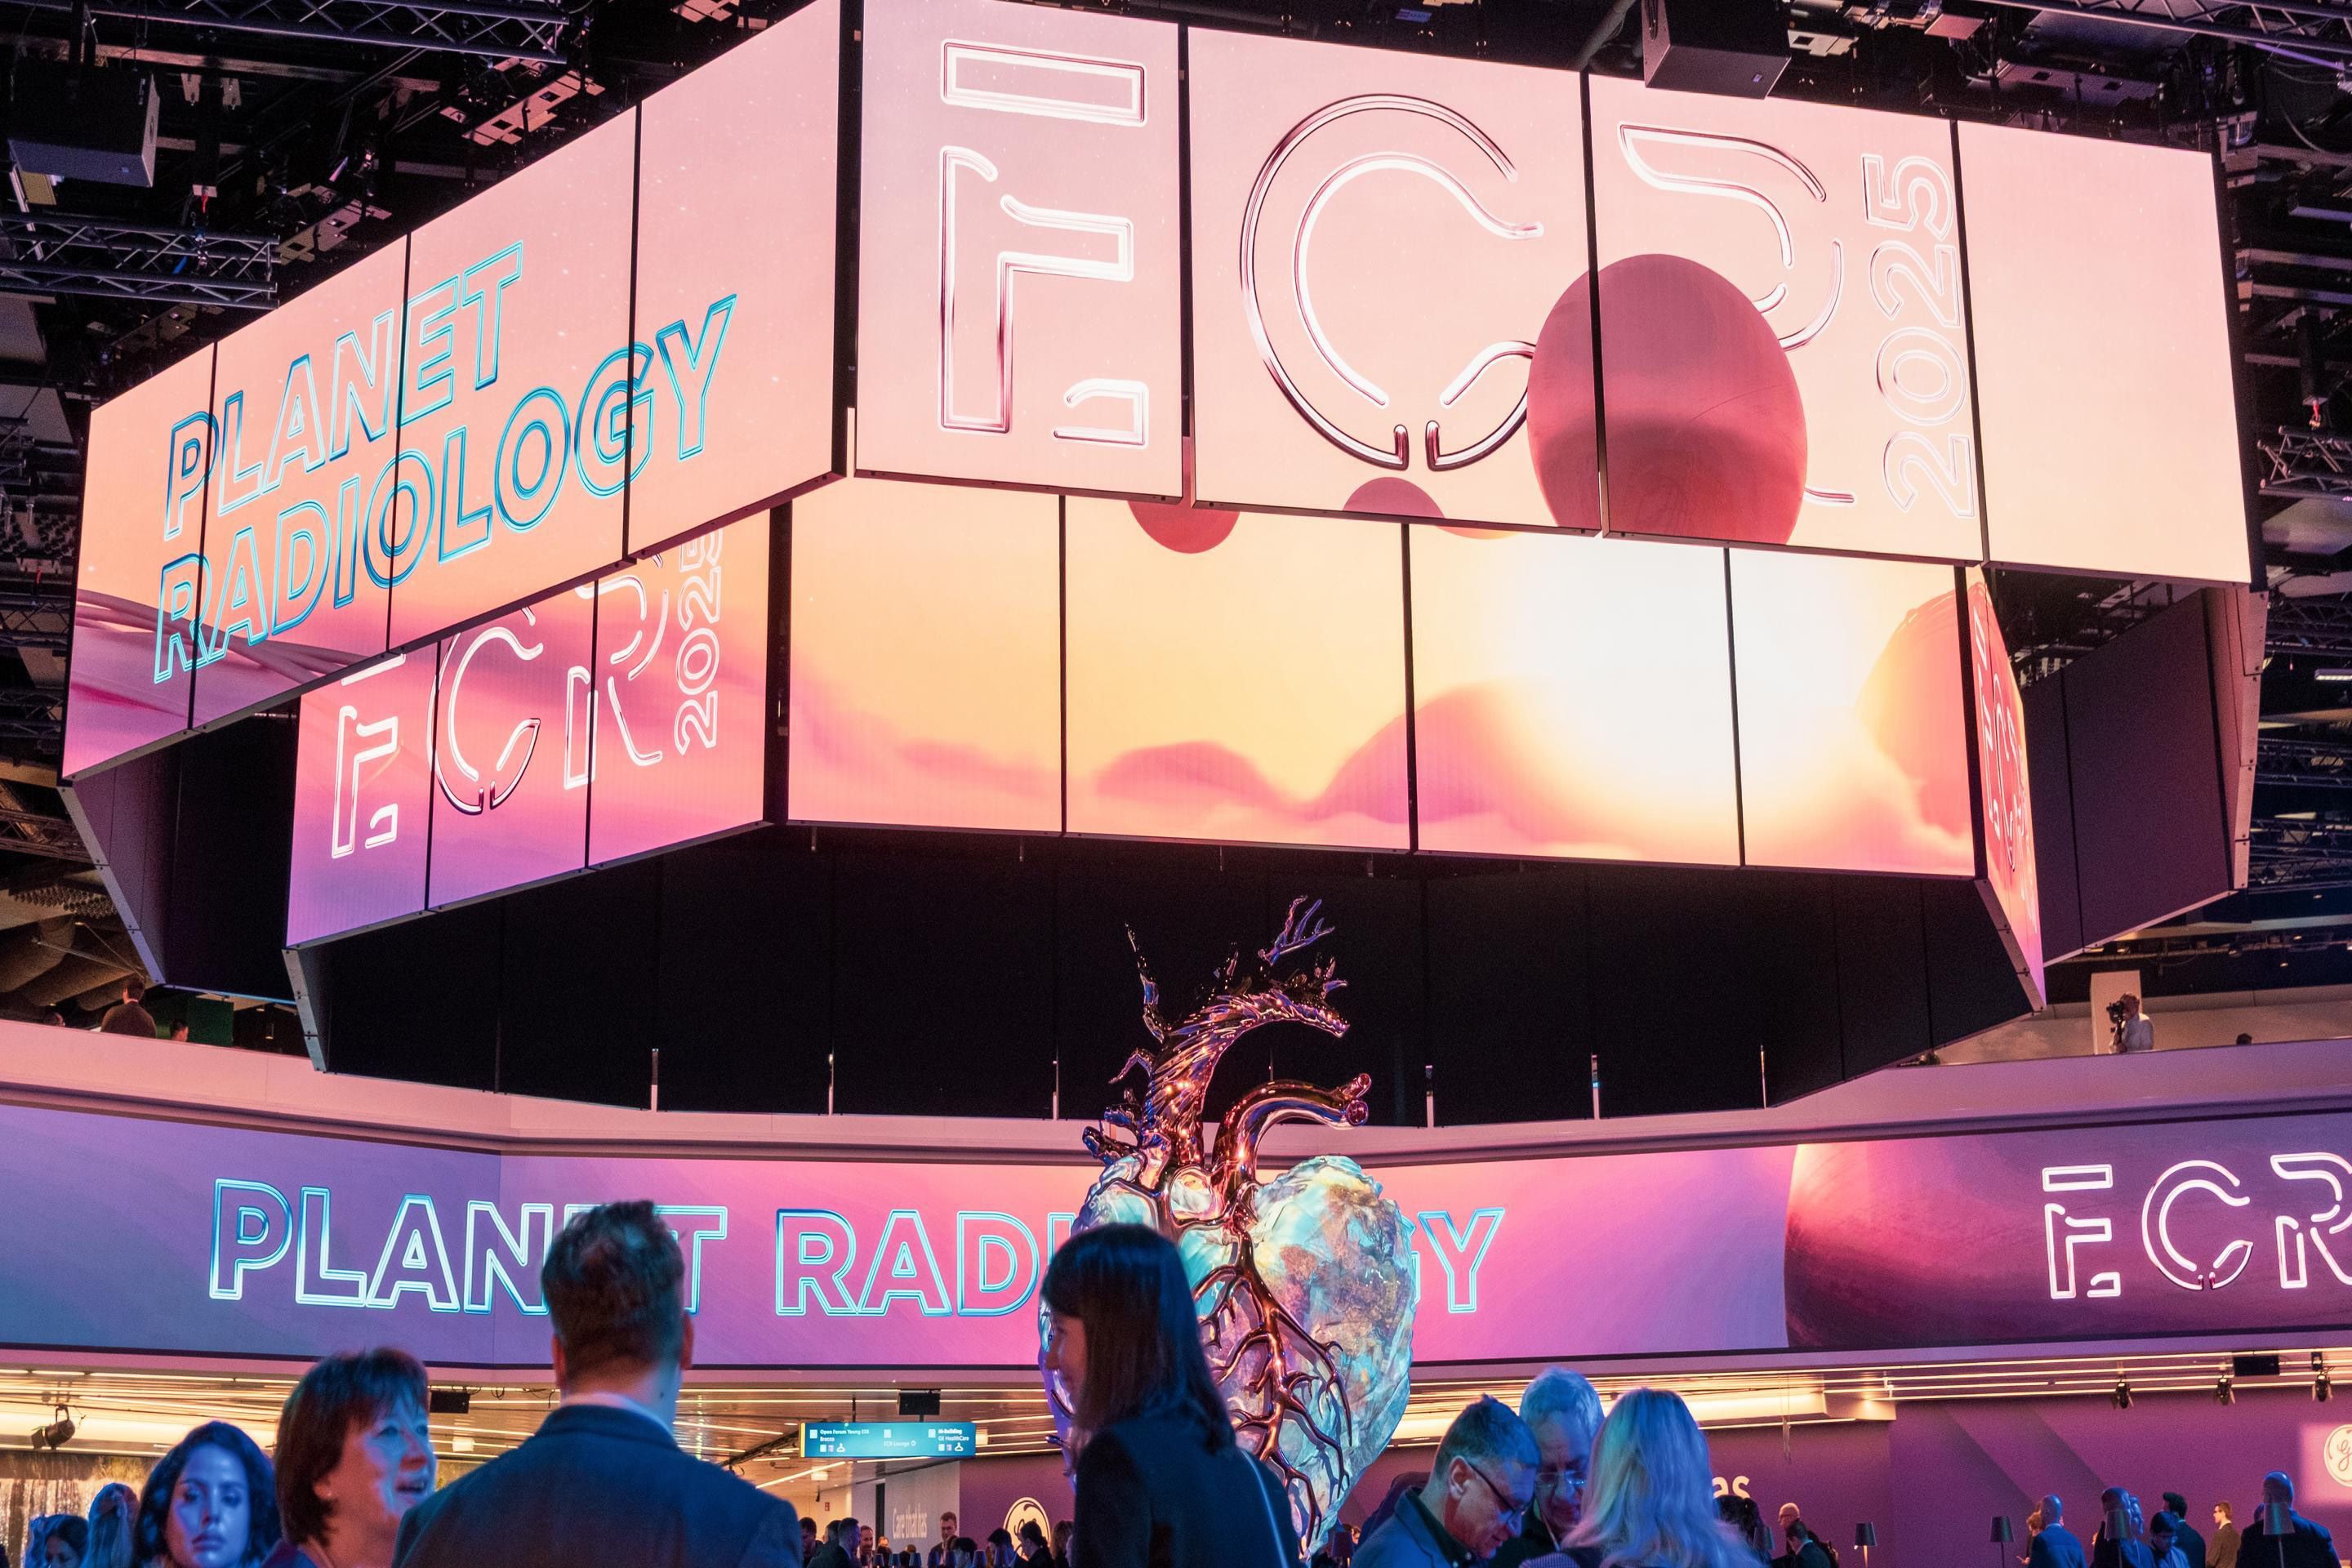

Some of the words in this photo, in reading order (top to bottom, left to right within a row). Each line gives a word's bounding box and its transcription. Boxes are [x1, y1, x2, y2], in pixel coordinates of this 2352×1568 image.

[163, 240, 523, 541] PLANET
[1861, 154, 1976, 518] 2025
[153, 293, 737, 684] RADIOLOGY
[331, 554, 669, 859] ECR
[209, 1178, 728, 1316] PLANT
[2042, 1152, 2352, 1299] ECR
